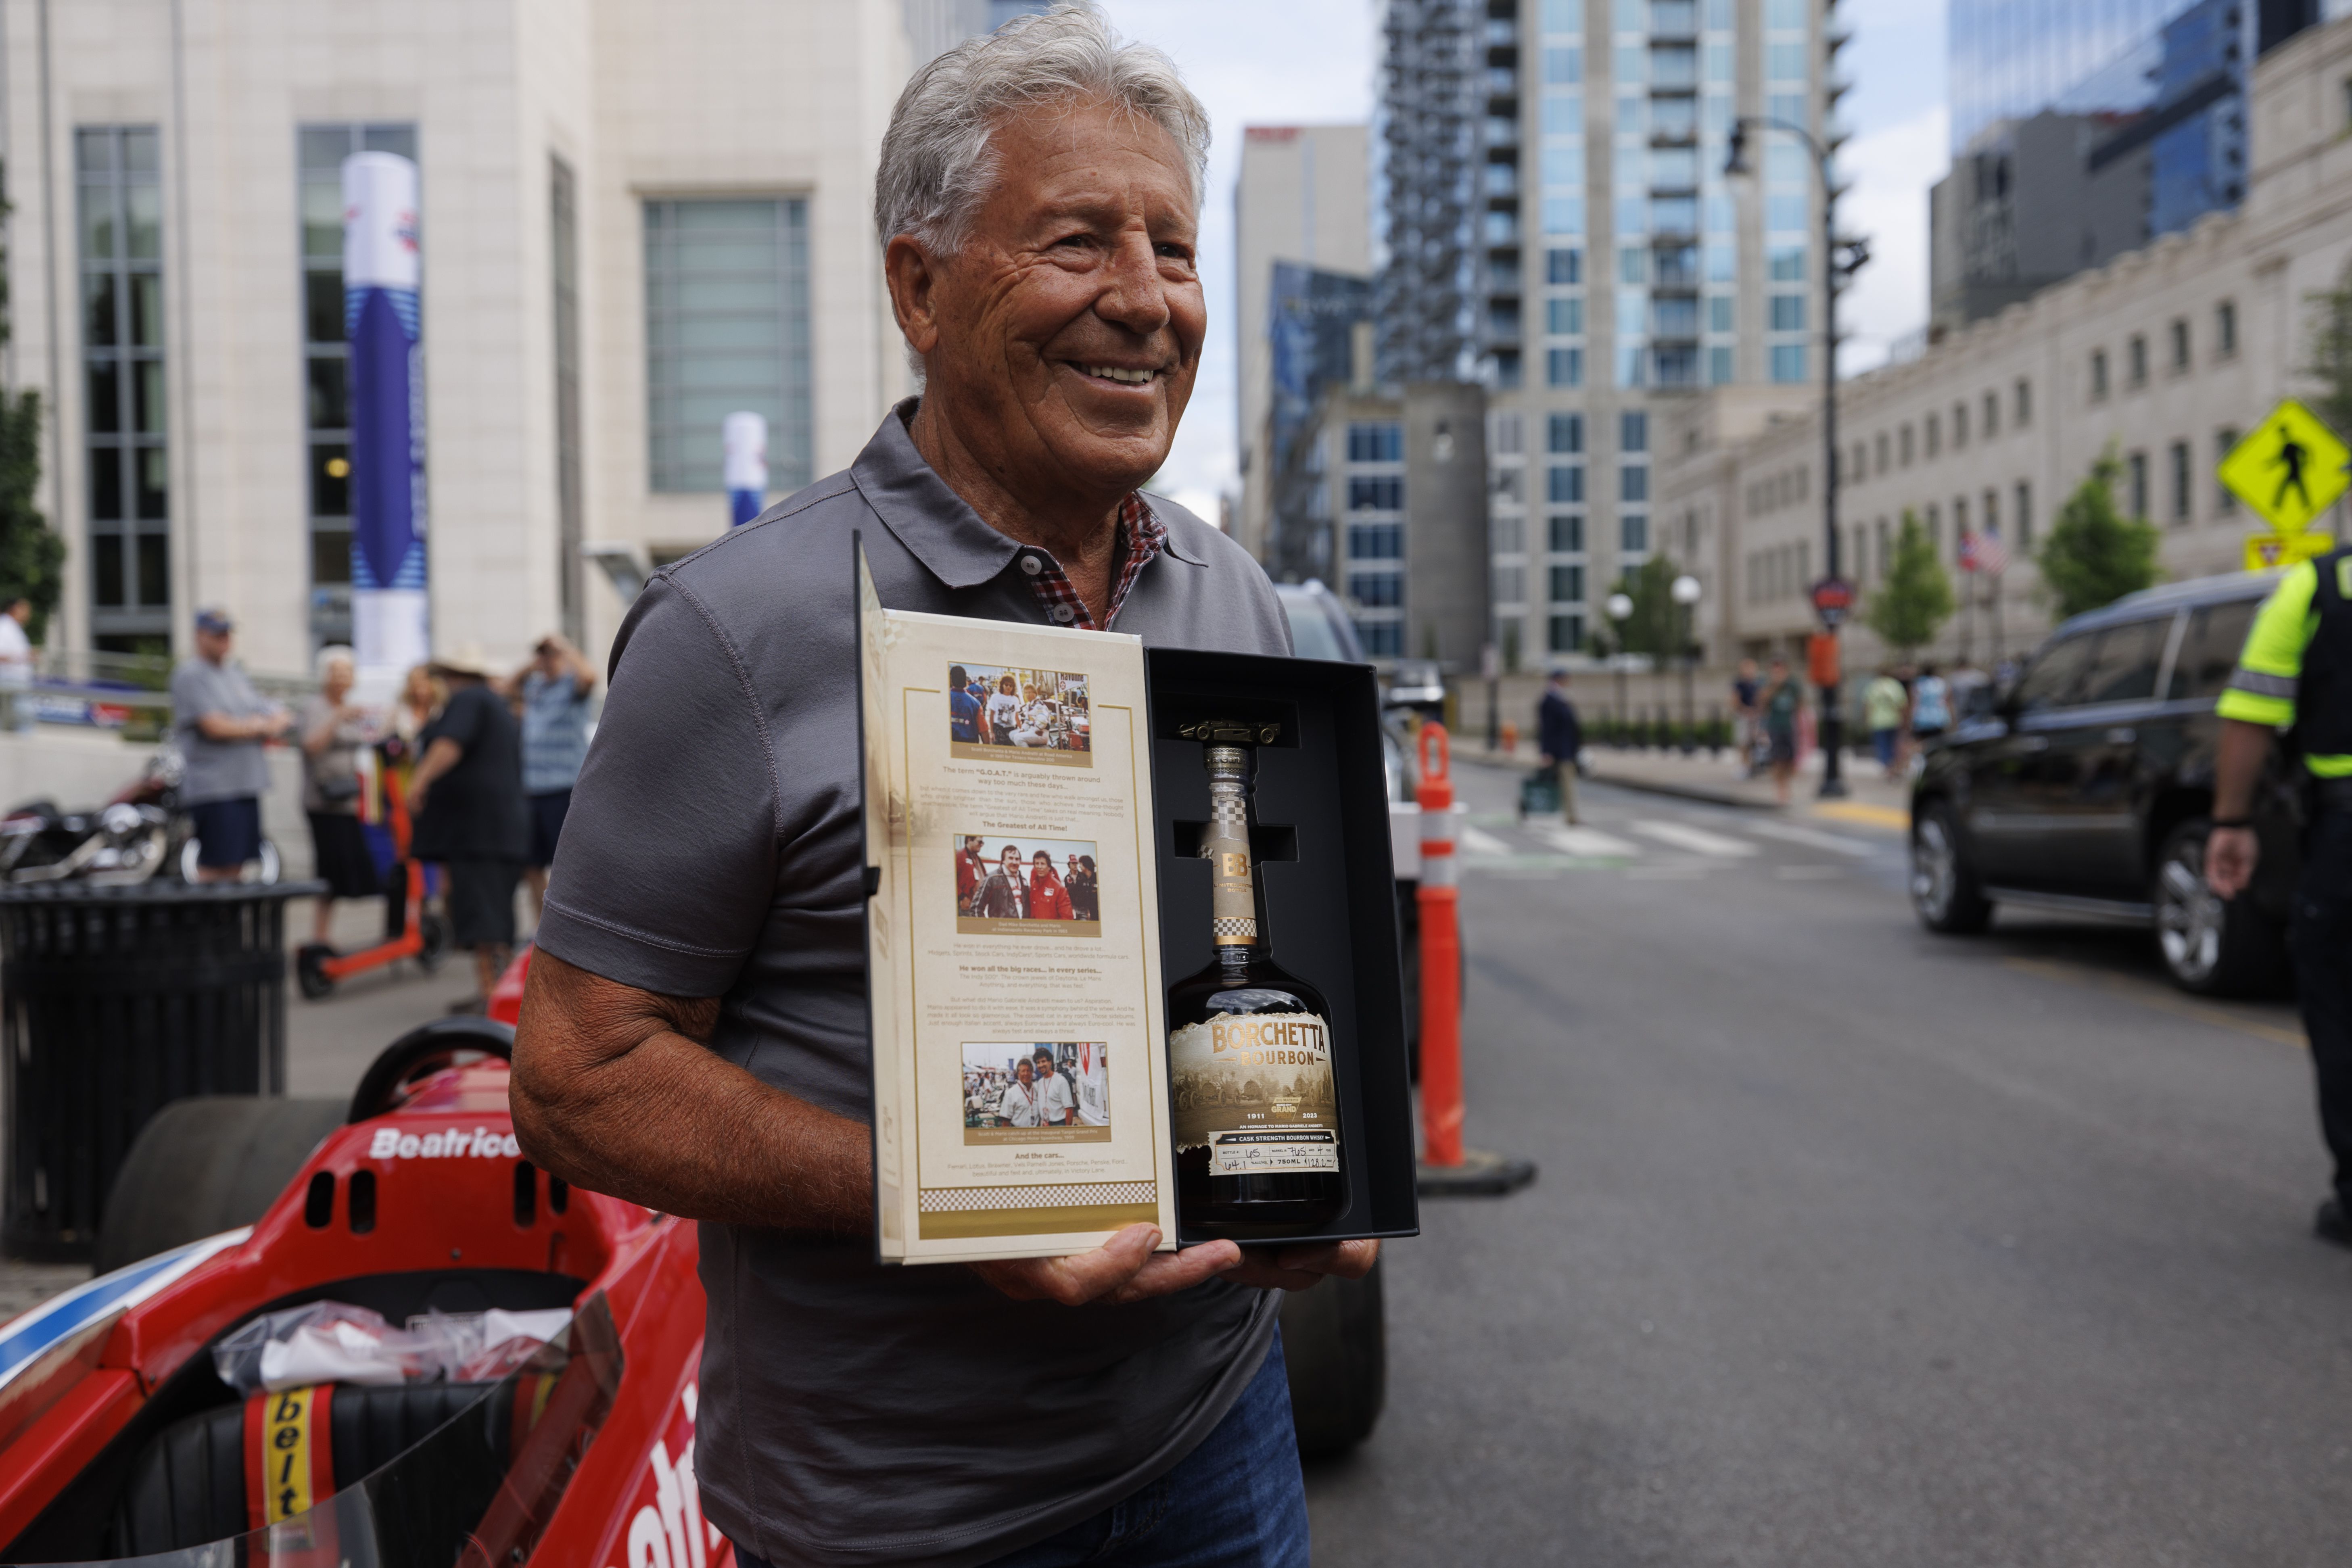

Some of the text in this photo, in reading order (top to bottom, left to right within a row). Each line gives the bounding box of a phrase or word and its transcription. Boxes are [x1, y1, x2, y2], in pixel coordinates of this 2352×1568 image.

[976, 768, 1012, 777] “G.O.A.T.”
[1020, 771, 1050, 781] arguably
[1222, 853, 1247, 877] BB
[1010, 965, 1021, 973] big
[1212, 1022, 1325, 1054] BORCHETTA
[1240, 1050, 1314, 1065] BOURBON
[369, 1126, 522, 1159] Beatrice
[1318, 1145, 1323, 1155] 4
